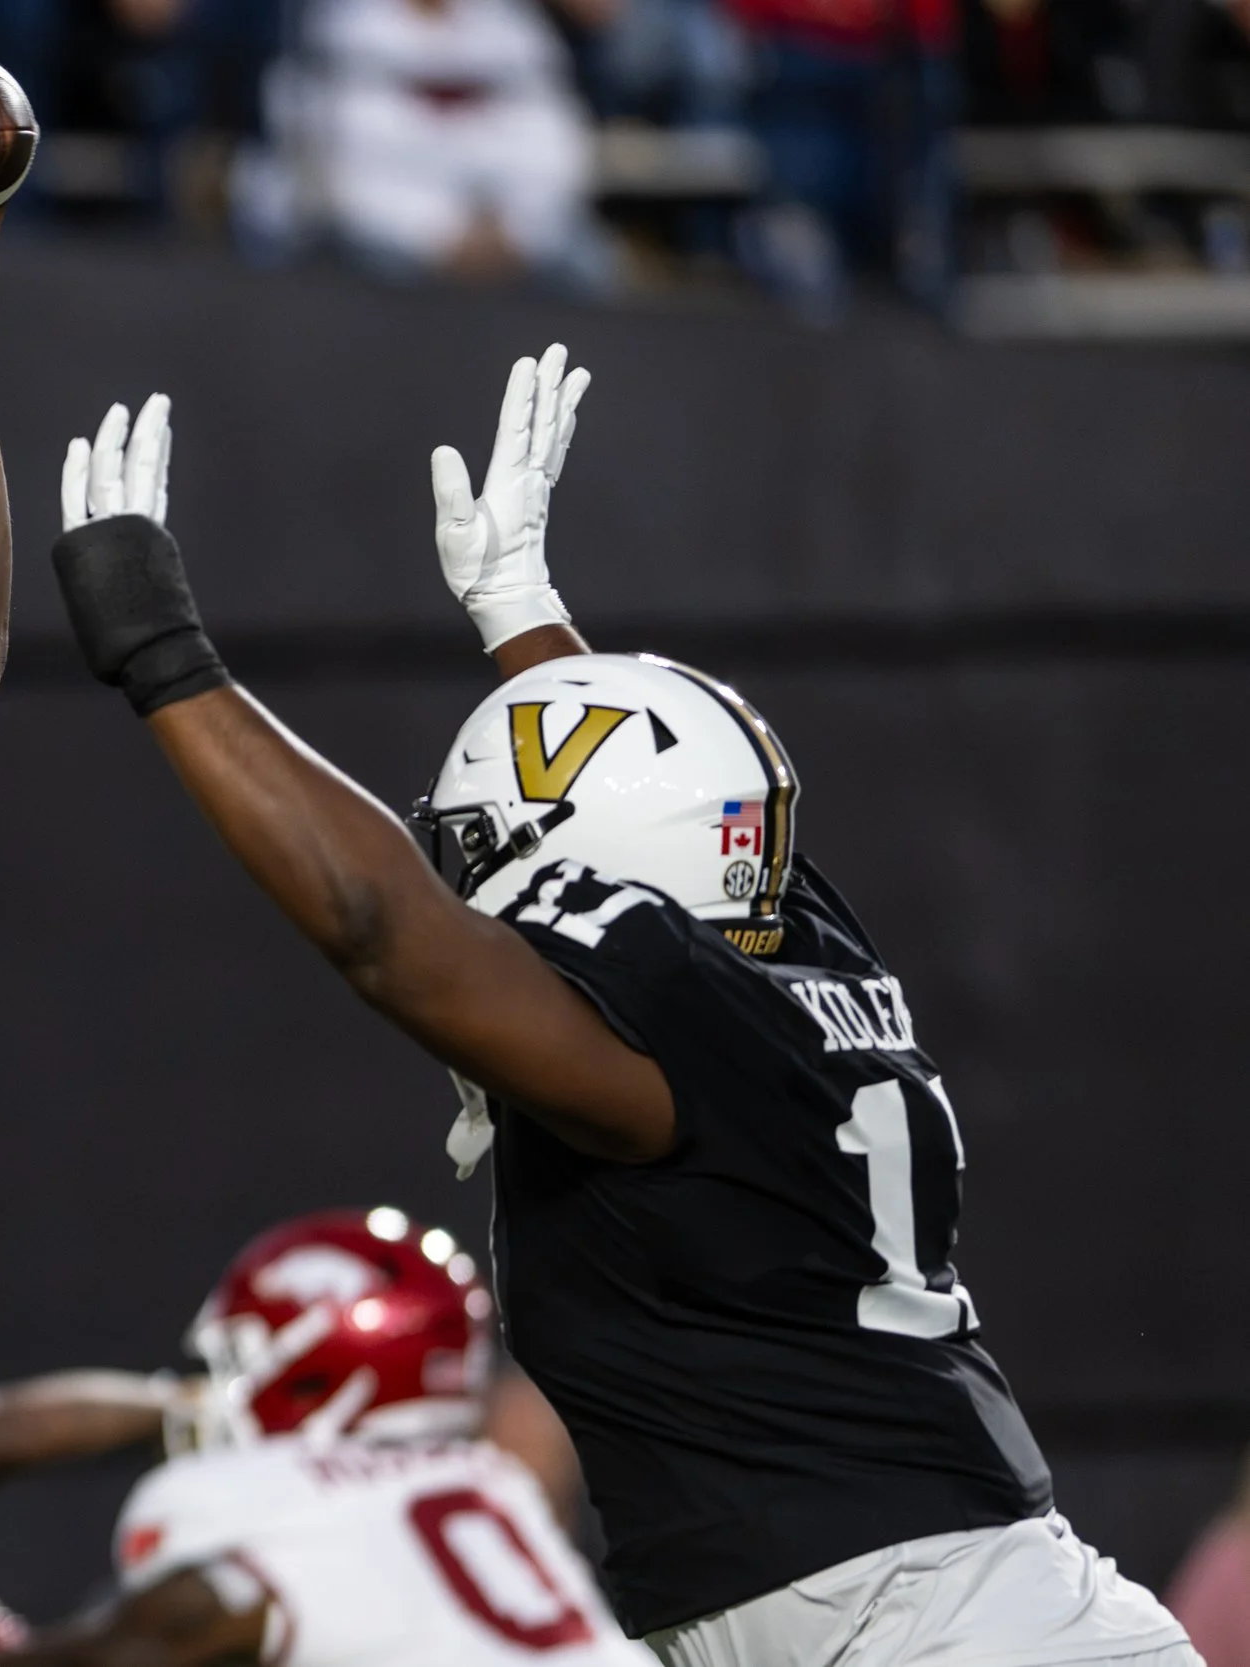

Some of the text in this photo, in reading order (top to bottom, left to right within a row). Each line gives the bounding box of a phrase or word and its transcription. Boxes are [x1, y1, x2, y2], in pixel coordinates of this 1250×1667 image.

[507, 702, 639, 803] V
[725, 861, 753, 898] SEC
[408, 1489, 597, 1651] 0
